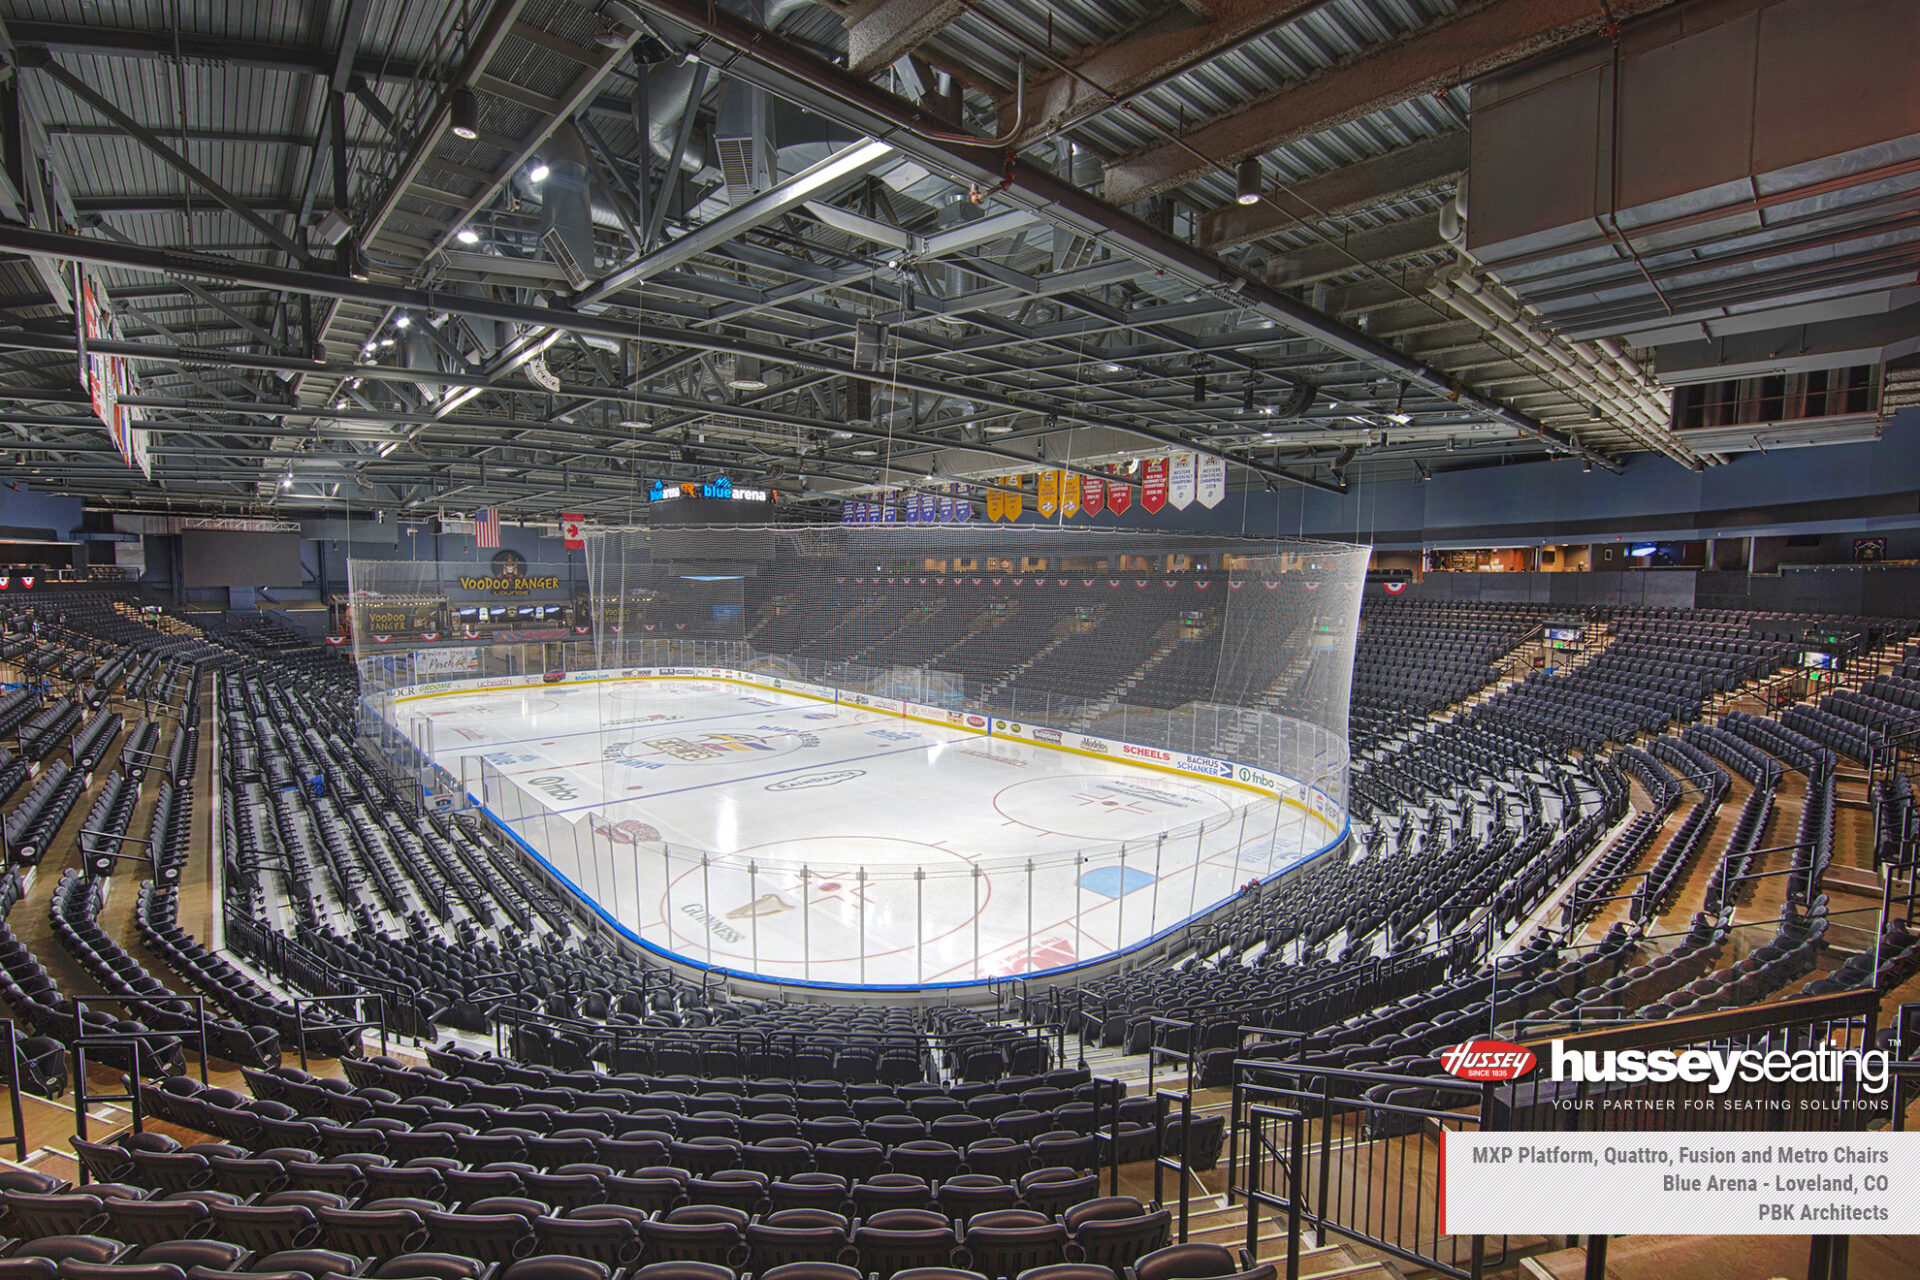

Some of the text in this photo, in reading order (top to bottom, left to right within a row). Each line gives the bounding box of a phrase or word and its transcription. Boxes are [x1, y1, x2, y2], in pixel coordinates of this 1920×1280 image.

[460, 577, 559, 590] VOODOO RANGER
[369, 613, 405, 622] VOODOO
[369, 622, 405, 631] RANGER
[420, 683, 451, 692] GROOME
[477, 678, 512, 688] uchealth
[1083, 737, 1106, 750] Modelo
[1123, 745, 1170, 761] SCHEELS
[1177, 761, 1218, 776] SCHANKER
[1187, 756, 1218, 768] BACHUS
[1252, 772, 1274, 788] fnbo
[681, 903, 746, 943] GUINNESS
